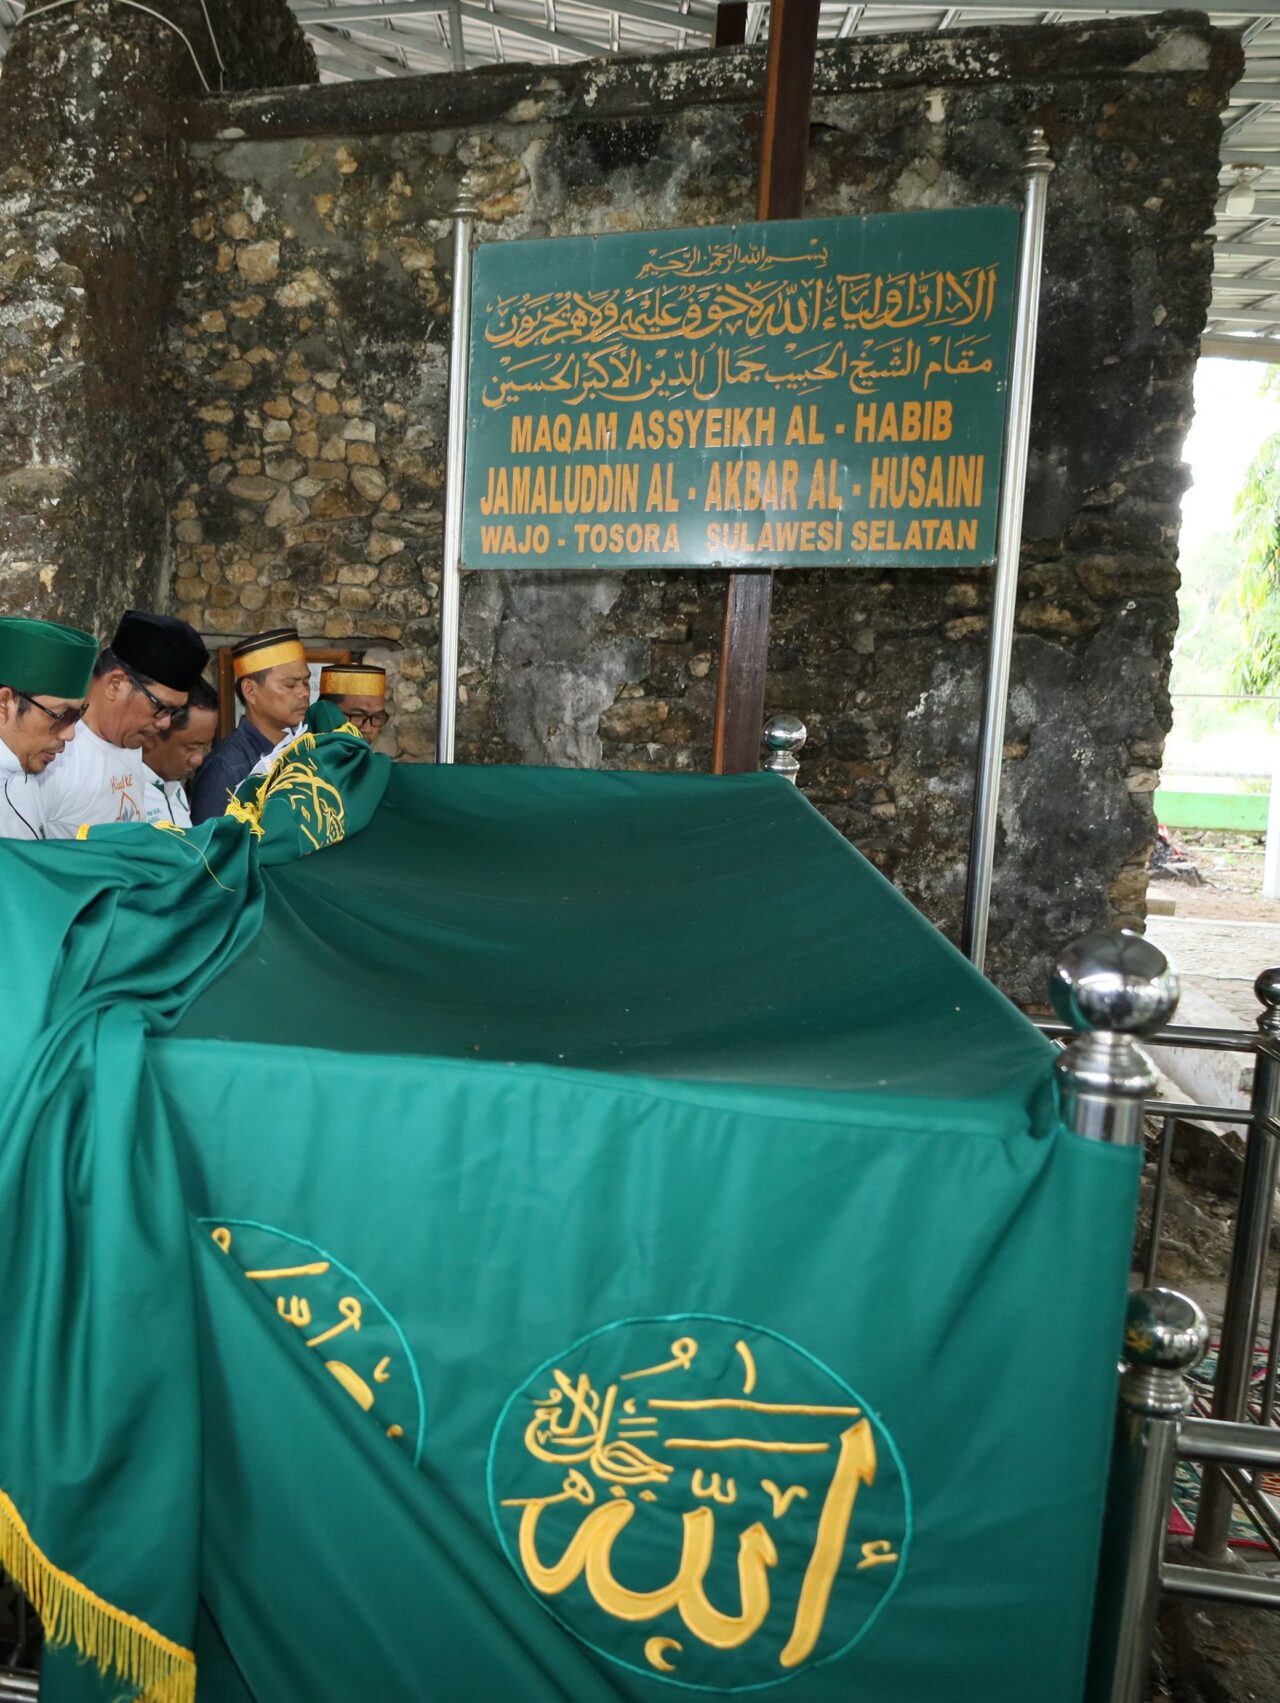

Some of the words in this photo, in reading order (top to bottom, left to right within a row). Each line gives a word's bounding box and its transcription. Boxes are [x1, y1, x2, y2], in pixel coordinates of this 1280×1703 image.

[511, 412, 618, 454] MAQAM
[626, 406, 776, 450] ASSYEIKH
[785, 404, 825, 446] AL
[854, 400, 953, 443] HABIB
[480, 463, 639, 517] JAMALUDDIN
[645, 462, 680, 513] AL
[704, 459, 799, 512] AKBAR
[807, 458, 843, 511] AL
[869, 455, 985, 509] HUSAINI
[480, 524, 550, 554] WAJO
[575, 523, 680, 553] TOSORA
[705, 520, 842, 552] SULAWESI
[851, 519, 978, 551] SELATAN
